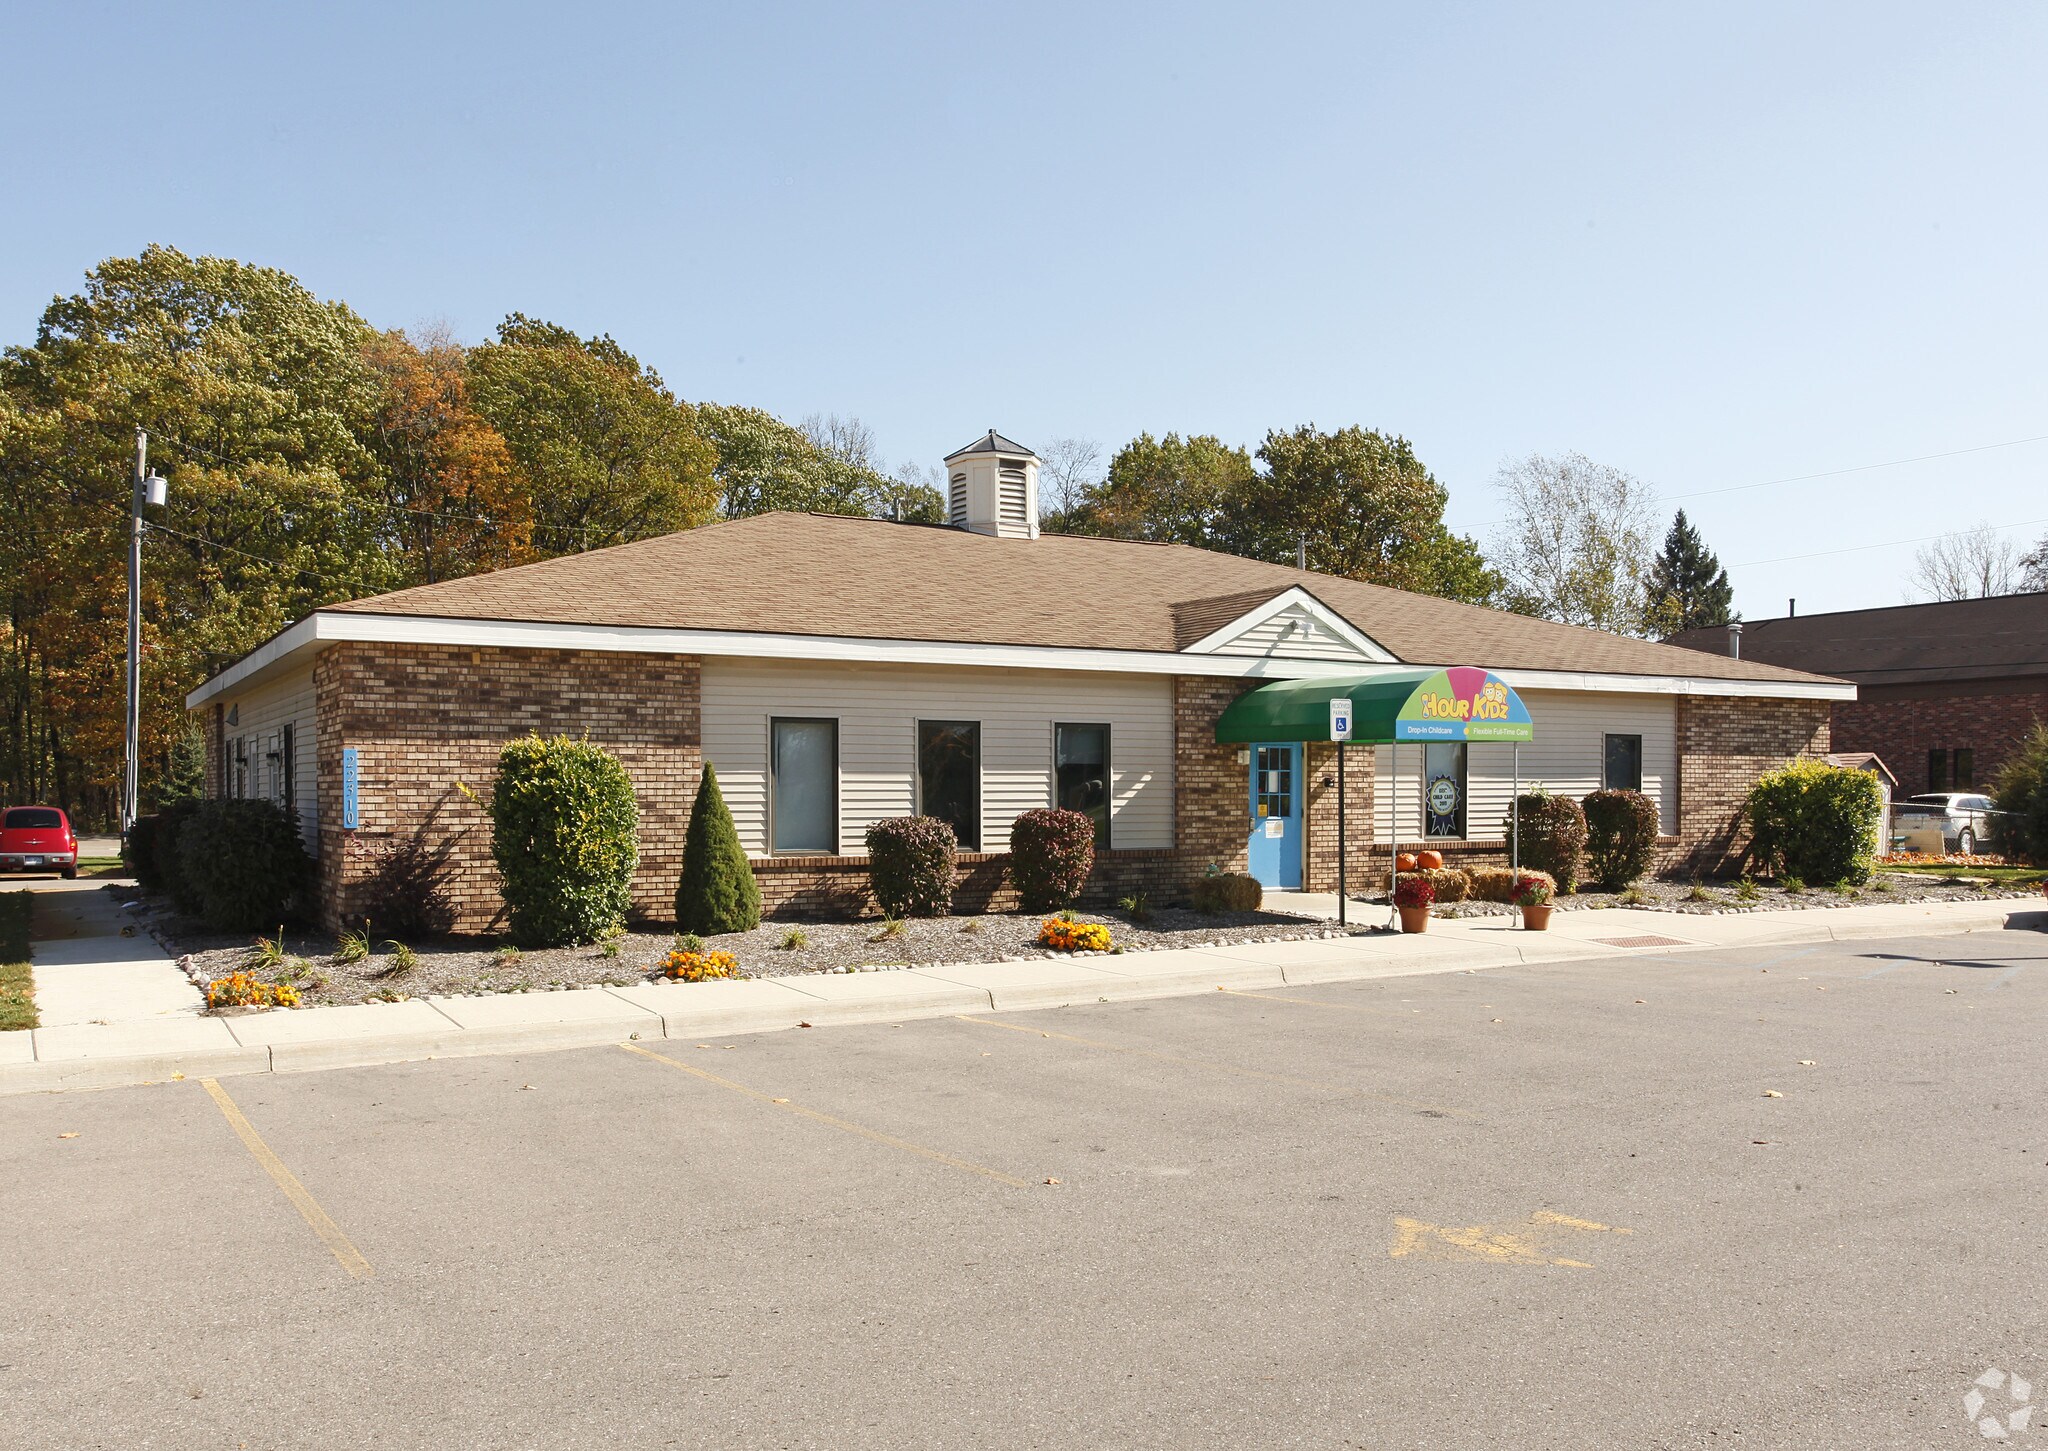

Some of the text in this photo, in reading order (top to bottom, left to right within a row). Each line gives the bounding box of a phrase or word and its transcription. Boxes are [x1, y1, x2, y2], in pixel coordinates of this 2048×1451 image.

[1422, 692, 1469, 718] HOUR
[1407, 726, 1427, 734] Drop-In
[1428, 726, 1452, 734] Childcare
[1473, 727, 1492, 735] Flexible
[1493, 728, 1515, 736] Full-Time
[345, 756, 354, 824] 22310
